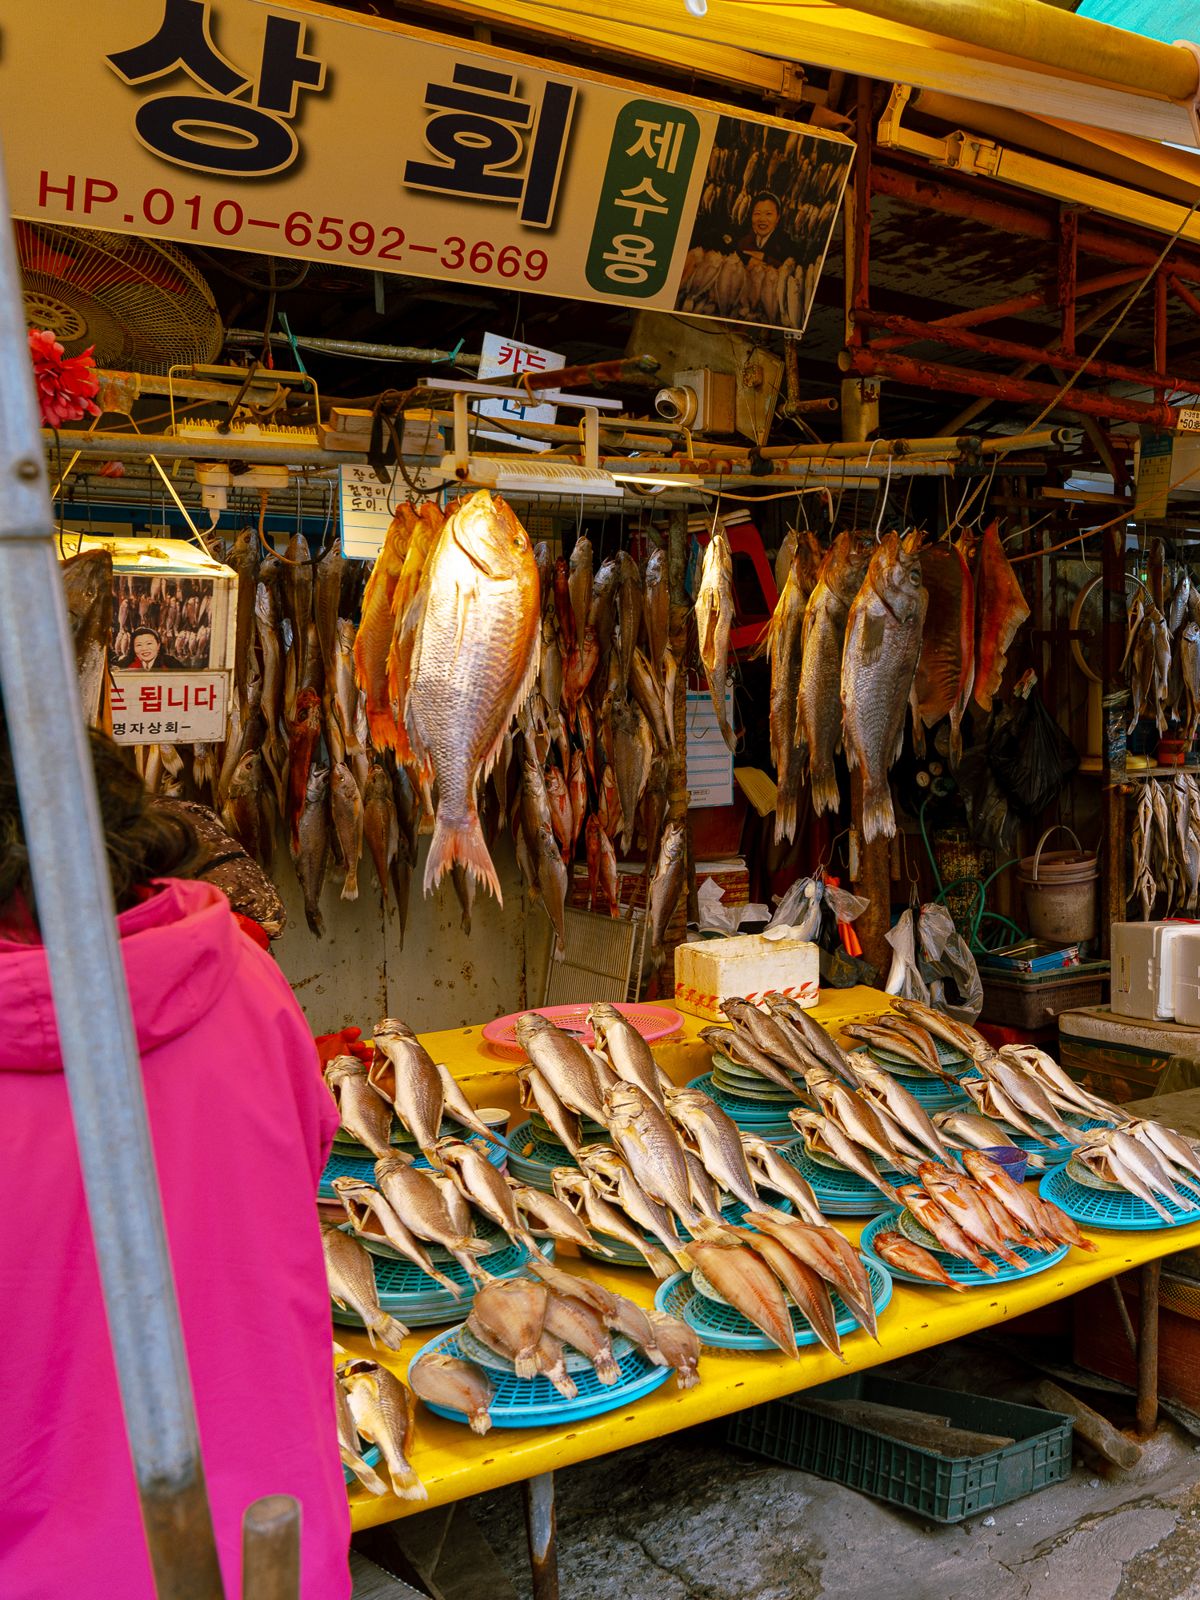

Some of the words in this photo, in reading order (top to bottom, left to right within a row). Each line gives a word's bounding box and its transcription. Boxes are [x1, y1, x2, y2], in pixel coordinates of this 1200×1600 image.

[105, 0, 574, 225] 상회
[38, 170, 549, 282] HP.010-6592-3669
[602, 119, 686, 284] 제수용
[498, 346, 546, 373] 카드
[139, 685, 217, 712] 됩니다
